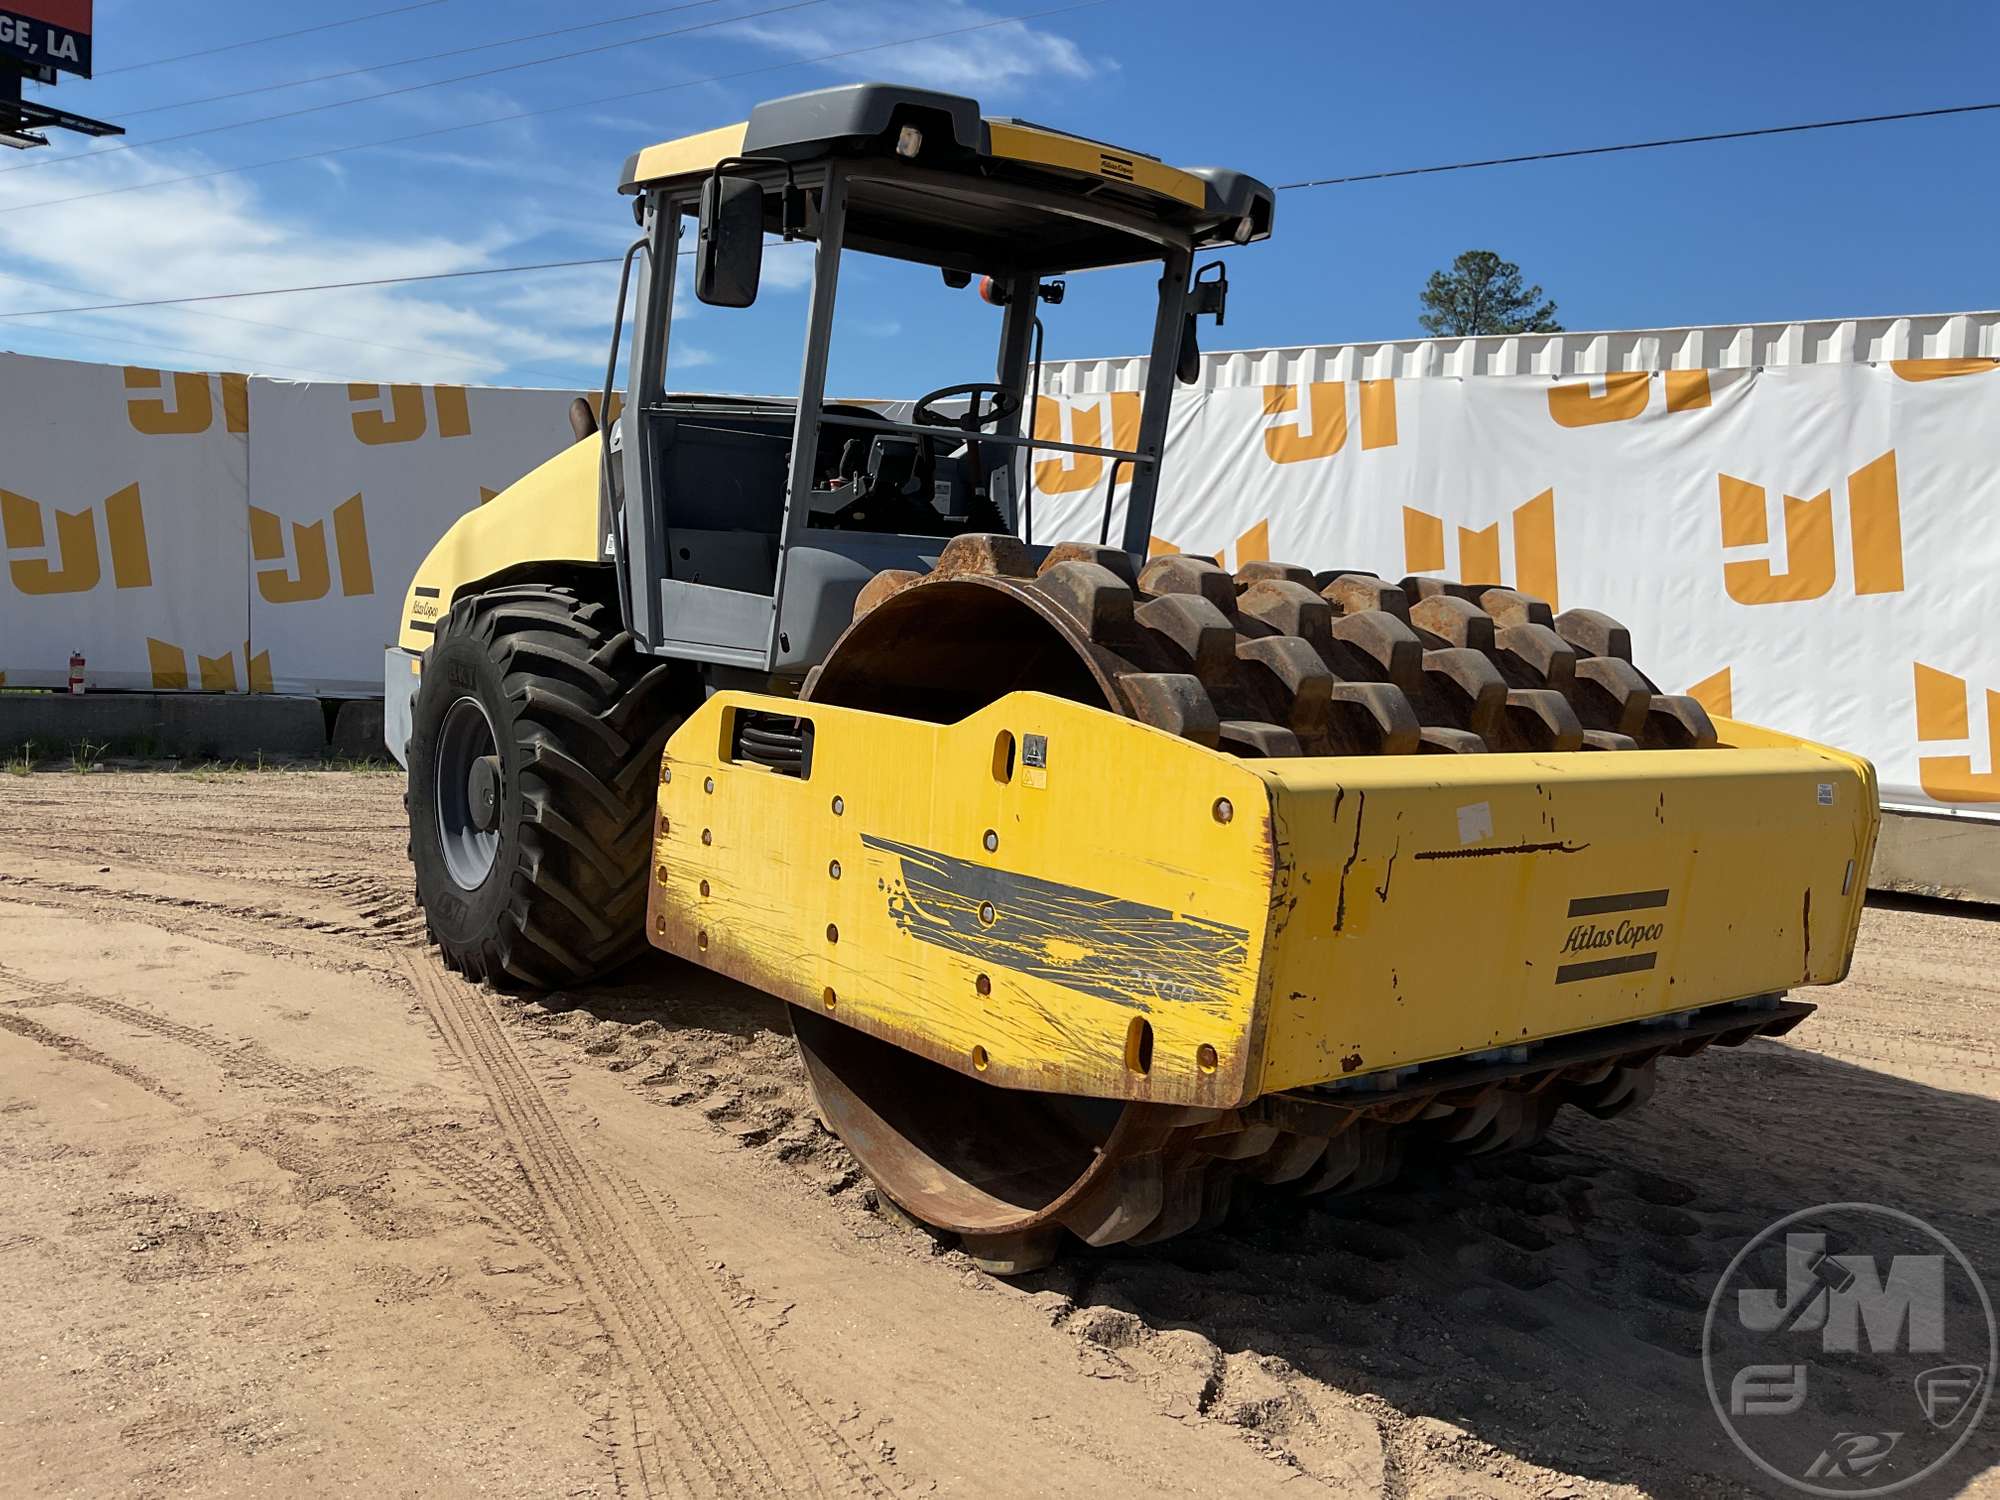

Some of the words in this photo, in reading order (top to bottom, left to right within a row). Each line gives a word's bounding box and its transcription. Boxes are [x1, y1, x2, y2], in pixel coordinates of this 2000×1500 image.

[46, 29, 80, 63] LA
[1559, 924, 1615, 955] Atlas
[1615, 919, 1664, 950] Copco
